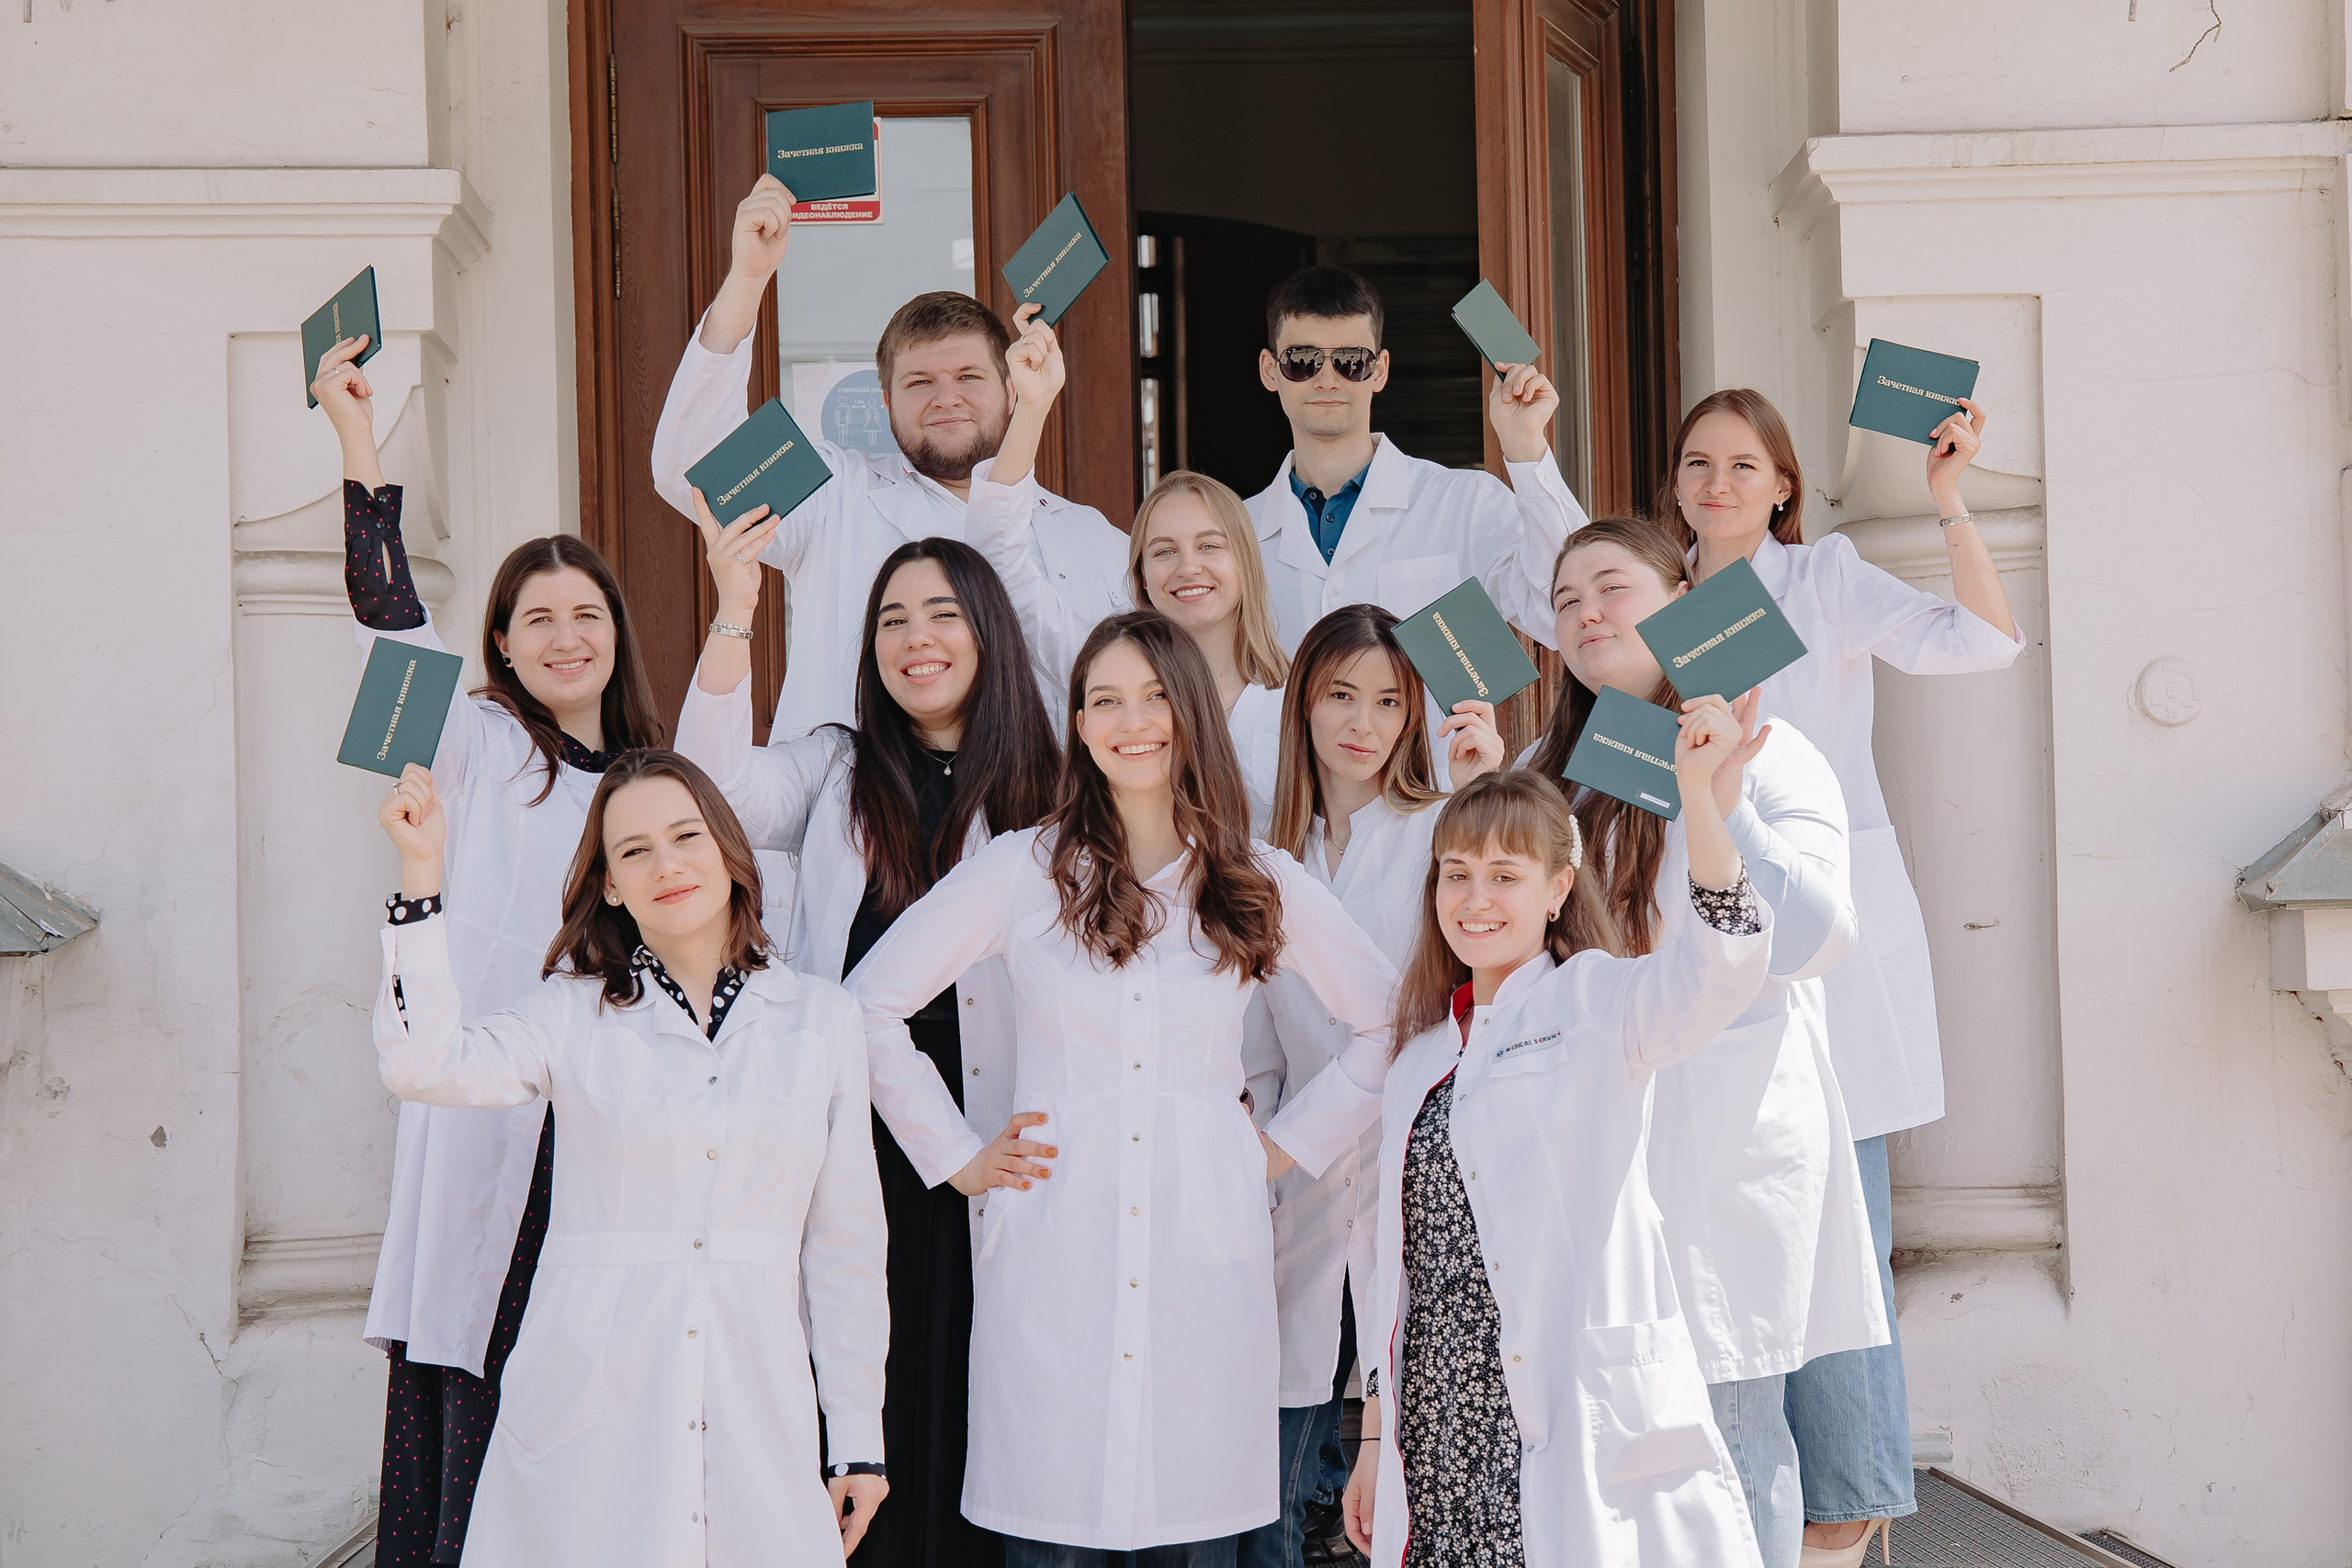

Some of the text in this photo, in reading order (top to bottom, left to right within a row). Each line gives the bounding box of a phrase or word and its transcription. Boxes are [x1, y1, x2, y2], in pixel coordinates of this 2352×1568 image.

[777, 143, 864, 158] Зачетная книжка
[810, 203, 849, 211] ВЕДЁТСЯ
[1023, 231, 1082, 298] Зачетная книжка
[1877, 375, 1960, 406] Зачетная книжк
[717, 439, 794, 505] Зачетная книжка
[1432, 612, 1489, 698] Зачетная книжка
[1672, 608, 1767, 669] Зачетная книжка
[377, 660, 417, 761] Зачетная книжка
[1593, 733, 1678, 775] ачетная книжка
[1506, 1031, 1561, 1053] MEDICAL SERVICE
